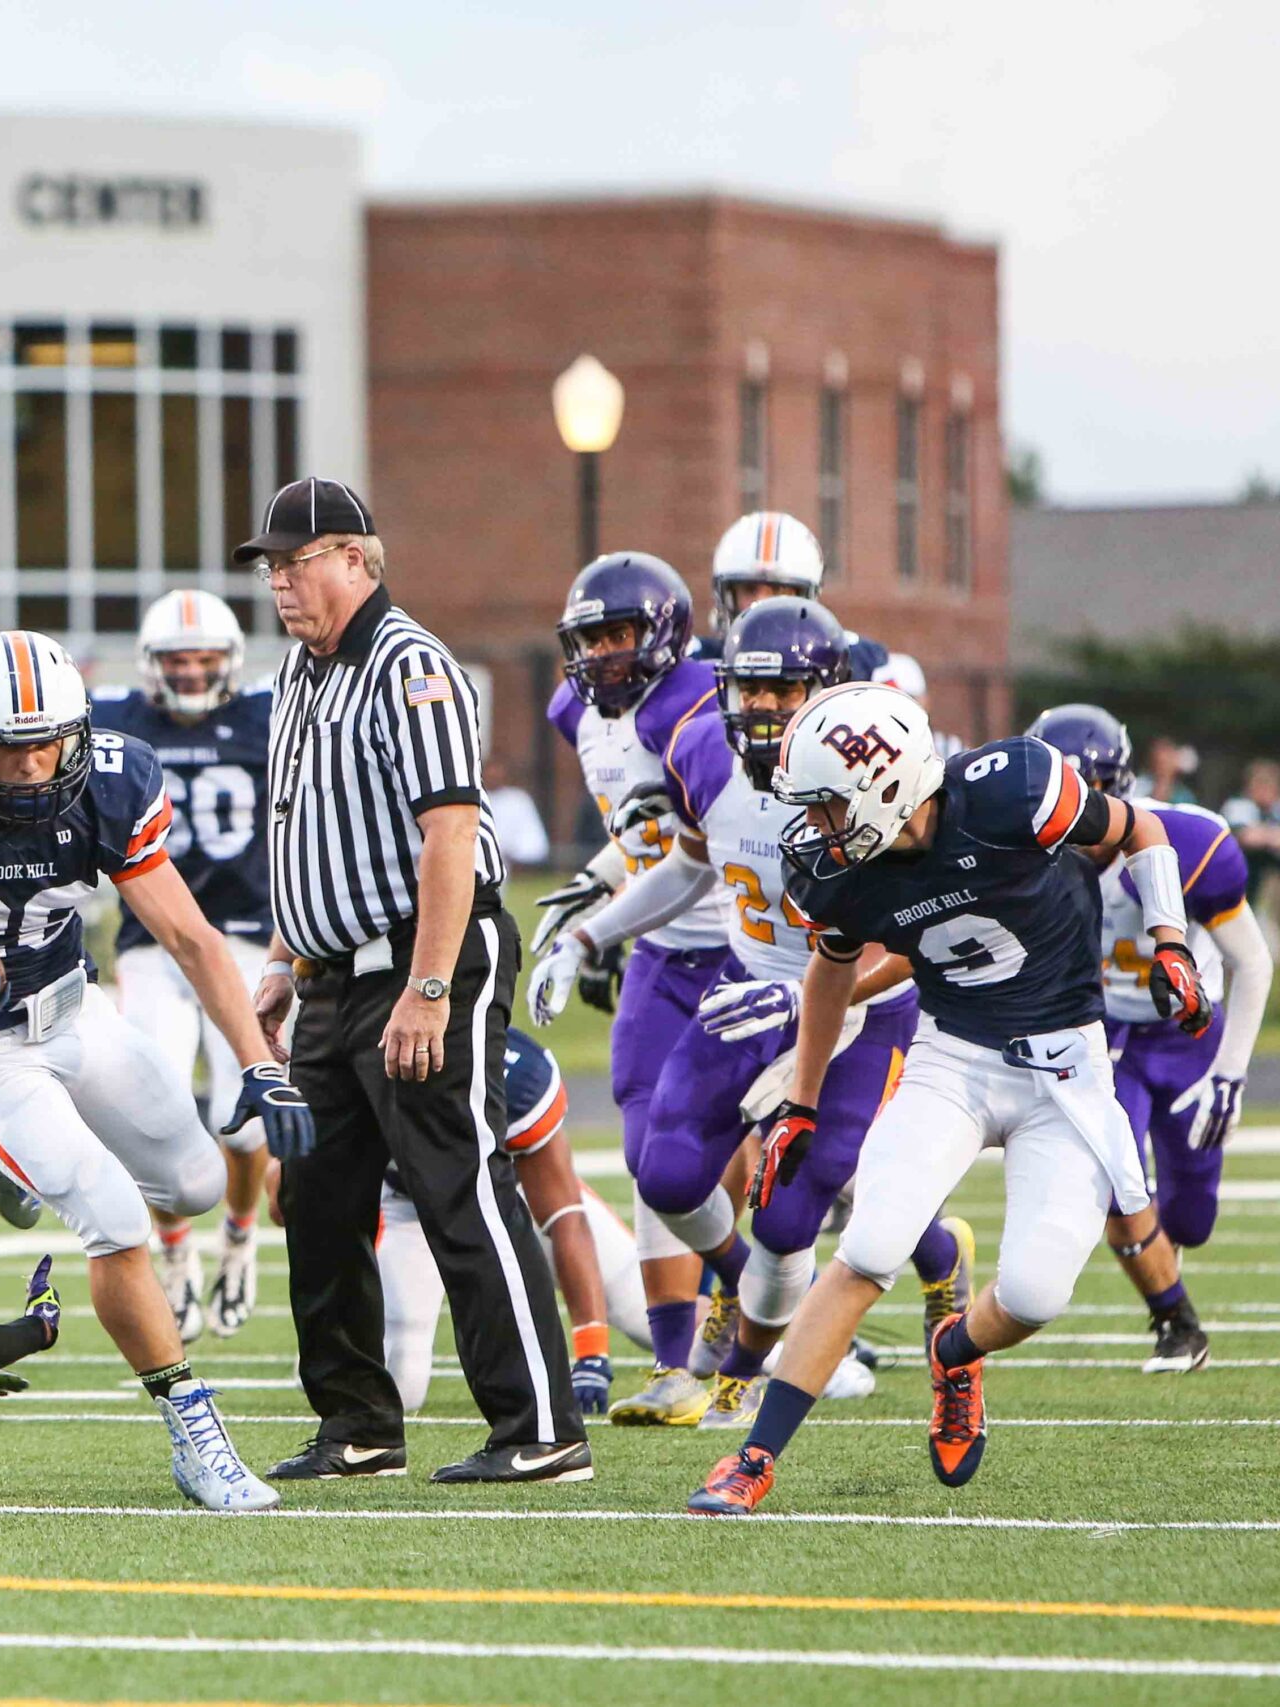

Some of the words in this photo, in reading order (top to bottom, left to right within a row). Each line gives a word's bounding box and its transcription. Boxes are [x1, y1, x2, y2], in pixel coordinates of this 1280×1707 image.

[19, 169, 209, 232] CENTER
[14, 713, 44, 725] Riddell
[964, 750, 1009, 782] 9
[26, 861, 58, 879] HILL
[893, 897, 943, 927] BROOK
[939, 888, 979, 909] HILL
[918, 913, 1029, 987] 9
